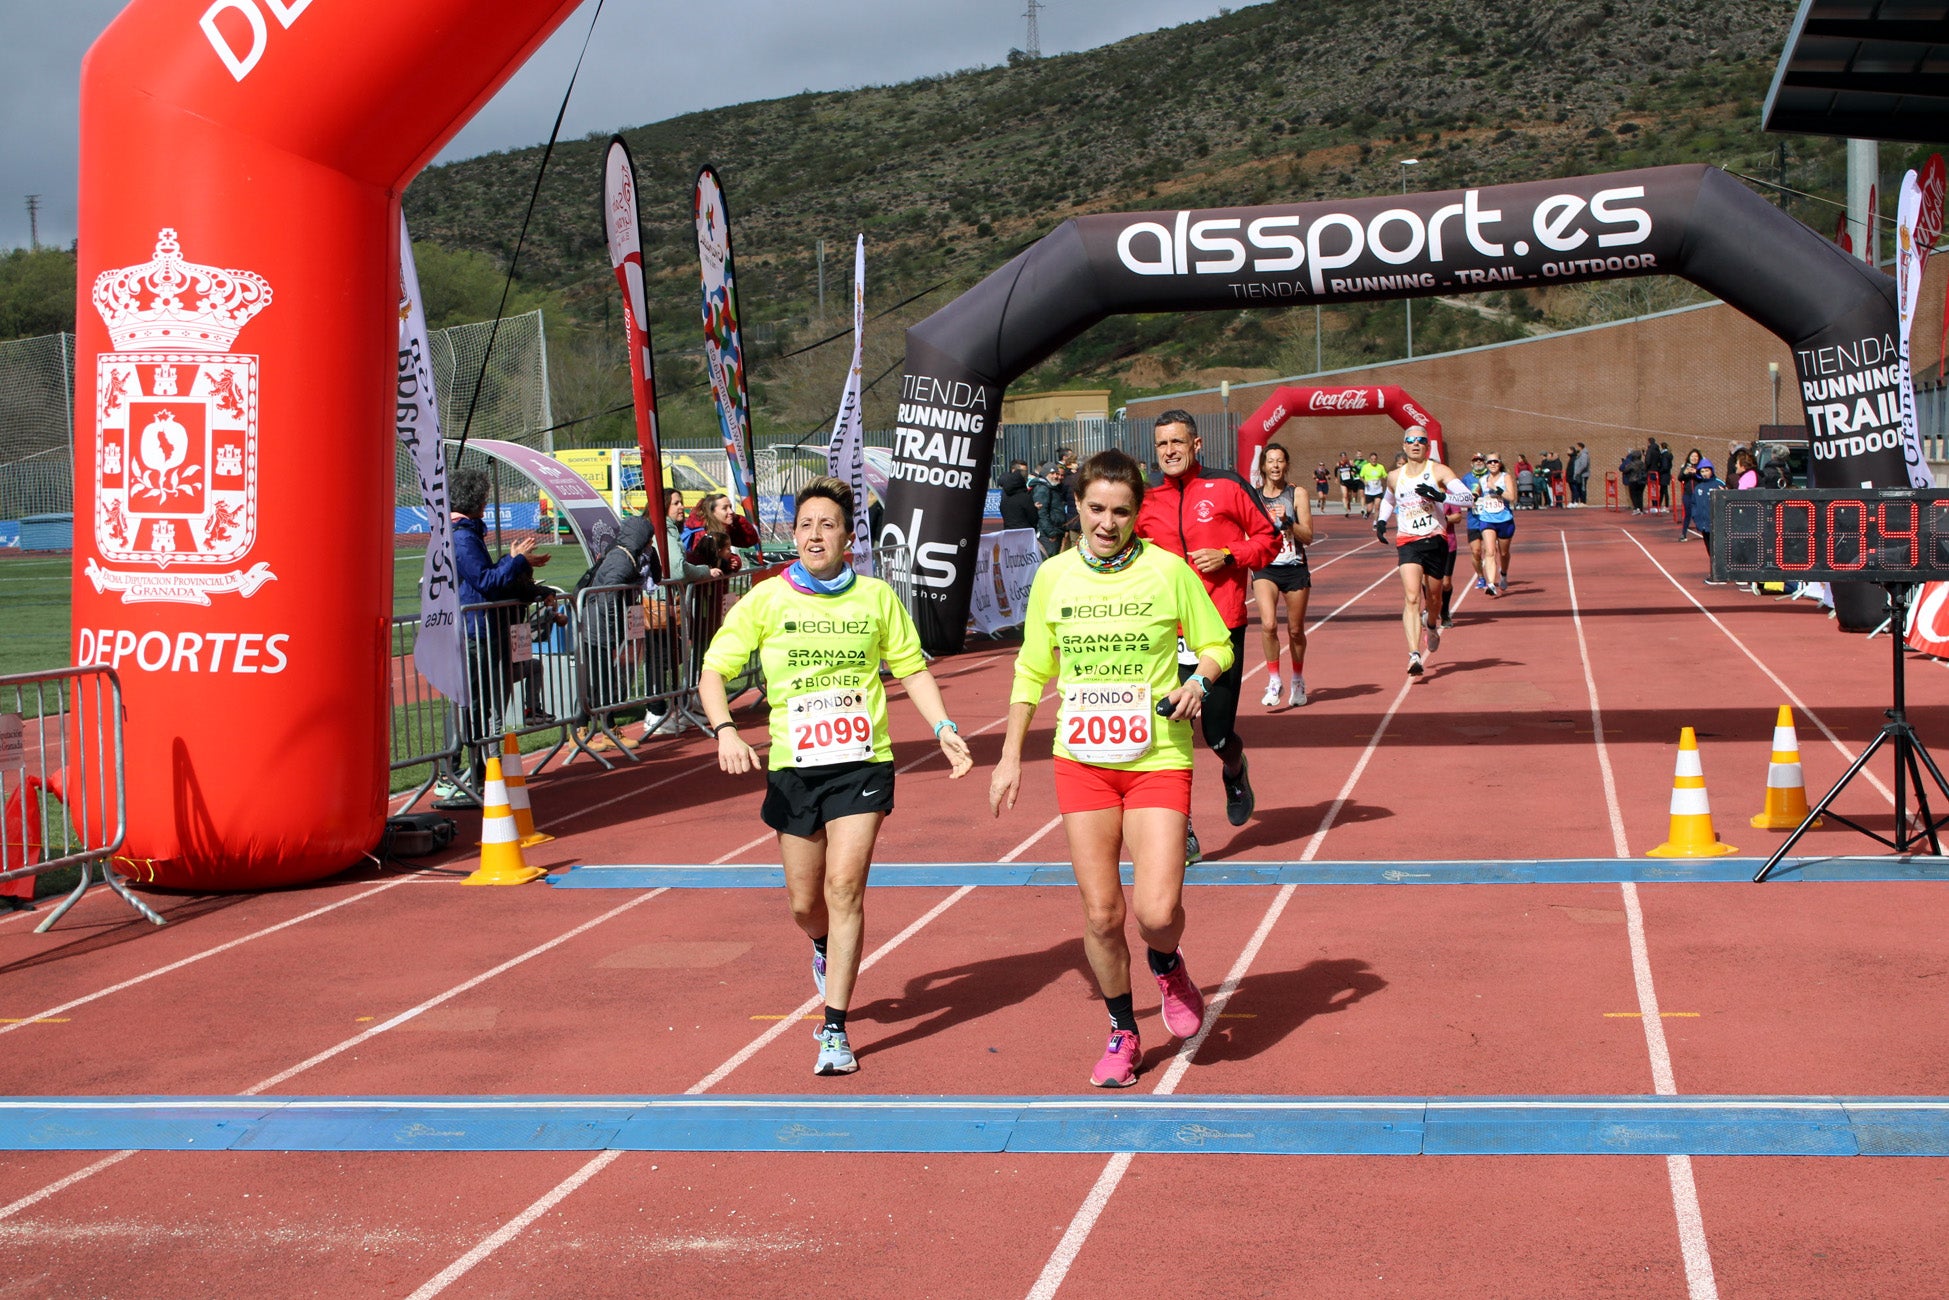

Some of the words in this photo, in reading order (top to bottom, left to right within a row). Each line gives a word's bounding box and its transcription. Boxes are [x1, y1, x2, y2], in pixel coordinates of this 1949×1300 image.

[1117, 186, 1652, 294] alssport.es
[1229, 280, 1309, 298] TIENDA
[1331, 272, 1435, 294] RUNNING
[1454, 265, 1523, 285] TRAIL
[1541, 253, 1658, 277] OUTDOOR
[1798, 333, 1898, 377] TIENDA
[903, 374, 987, 410] TIENDA
[1802, 364, 1900, 402] RUNNING
[897, 403, 984, 434] RUNNING
[1807, 391, 1902, 437] TRAIL
[1899, 340, 1919, 467] Granada
[894, 427, 977, 468] TRAIL
[889, 460, 973, 490] OUTDOOR
[1412, 514, 1433, 529] 447
[131, 584, 196, 597] GRANADA
[912, 589, 947, 602] shop
[79, 627, 290, 674] DEPORTES
[1062, 632, 1149, 645] GRANADA
[1064, 643, 1150, 654] RUNNERS
[787, 649, 866, 659] GRANADA
[1085, 663, 1143, 675] BIONER
[805, 675, 860, 688] BIONER
[806, 695, 853, 712] FONDO
[1082, 691, 1134, 705] FONDO
[795, 716, 870, 750] 2099
[1068, 715, 1148, 745] 2098
